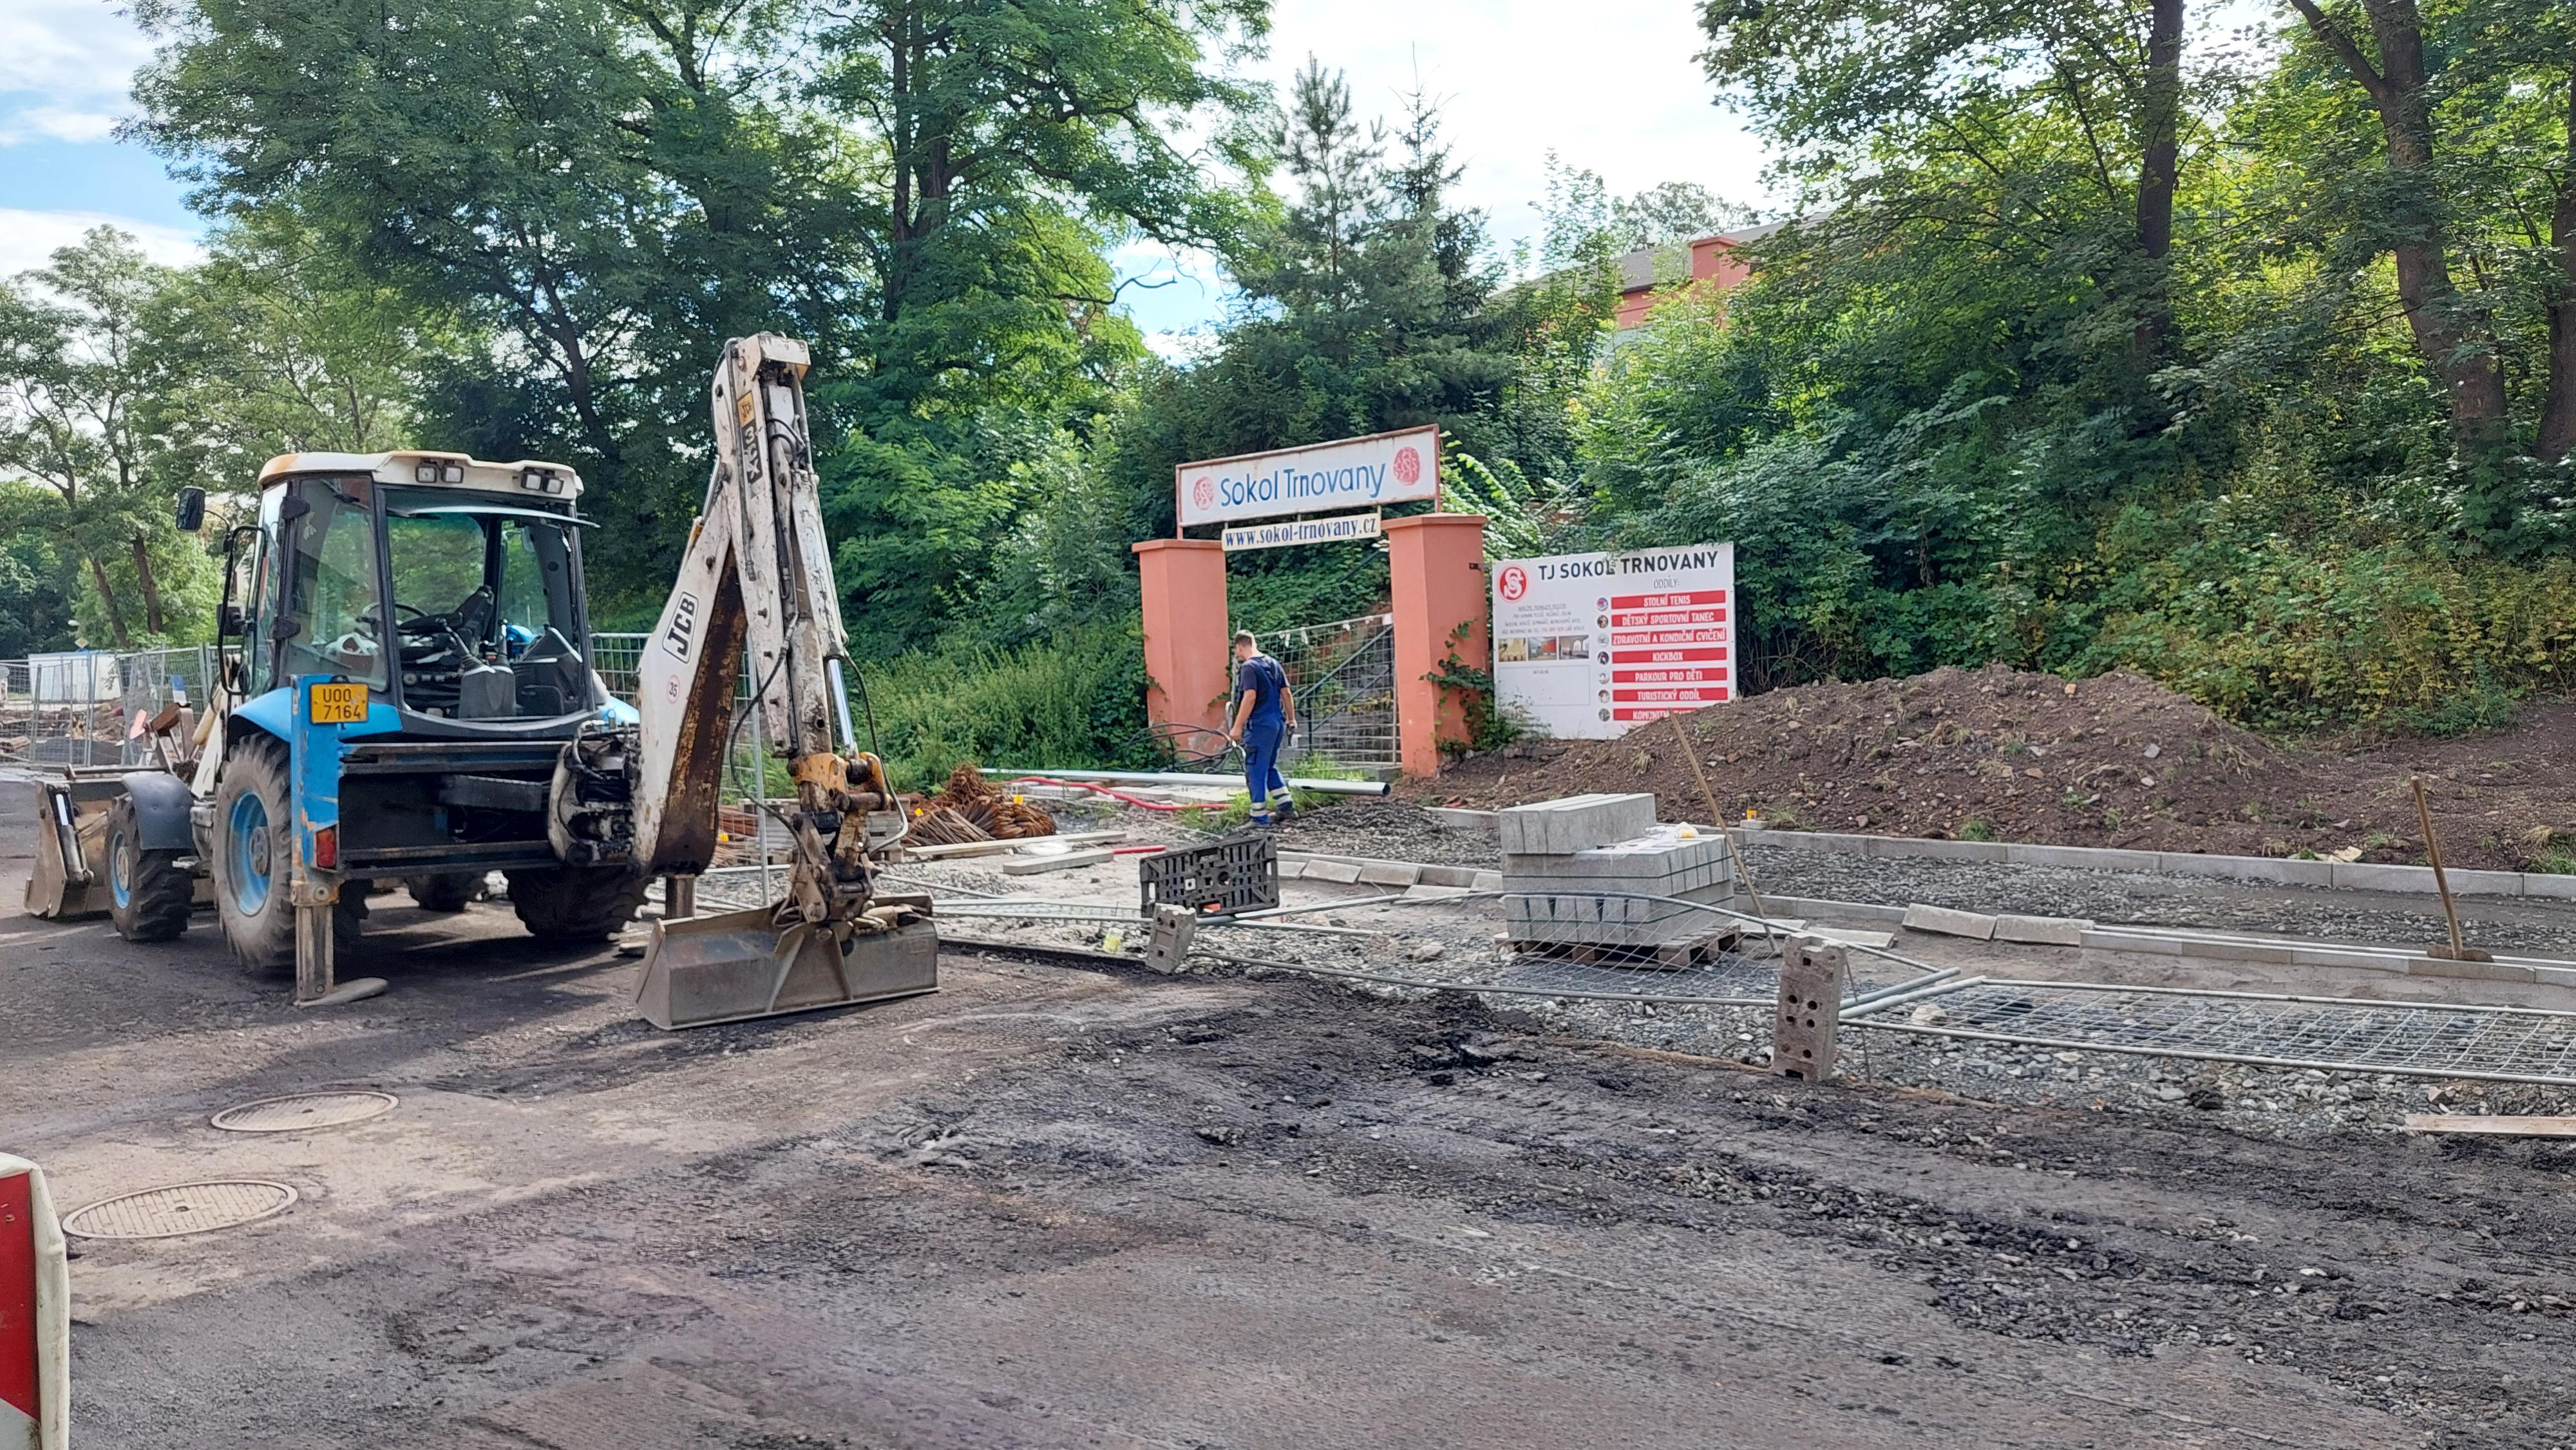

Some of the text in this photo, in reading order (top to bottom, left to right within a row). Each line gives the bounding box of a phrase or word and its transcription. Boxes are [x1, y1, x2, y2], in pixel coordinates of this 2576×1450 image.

[1220, 463, 1386, 507] Sokol Trnovany
[1226, 518, 1376, 547] www.sokol-trnovany.cz
[1539, 551, 1719, 580] TJ SOKOL TRNOVANY
[1643, 594, 1691, 607] STOLNÍ TENIS
[1622, 611, 1714, 626] DĚTSKÝ SPORTOVNÍ TANEC
[667, 598, 695, 656] JCB
[1613, 628, 1725, 645] ZDRAVOTNÍ A KONDIČNÍ CVIČENÍ
[1653, 652, 1683, 662] KICKBOX
[1634, 668, 1703, 682] PARKOUR PRO DĚTI
[669, 682, 678, 697] 35
[1636, 688, 1701, 701] TURISTICKÝ ODDÍL
[323, 704, 361, 720] 7164
